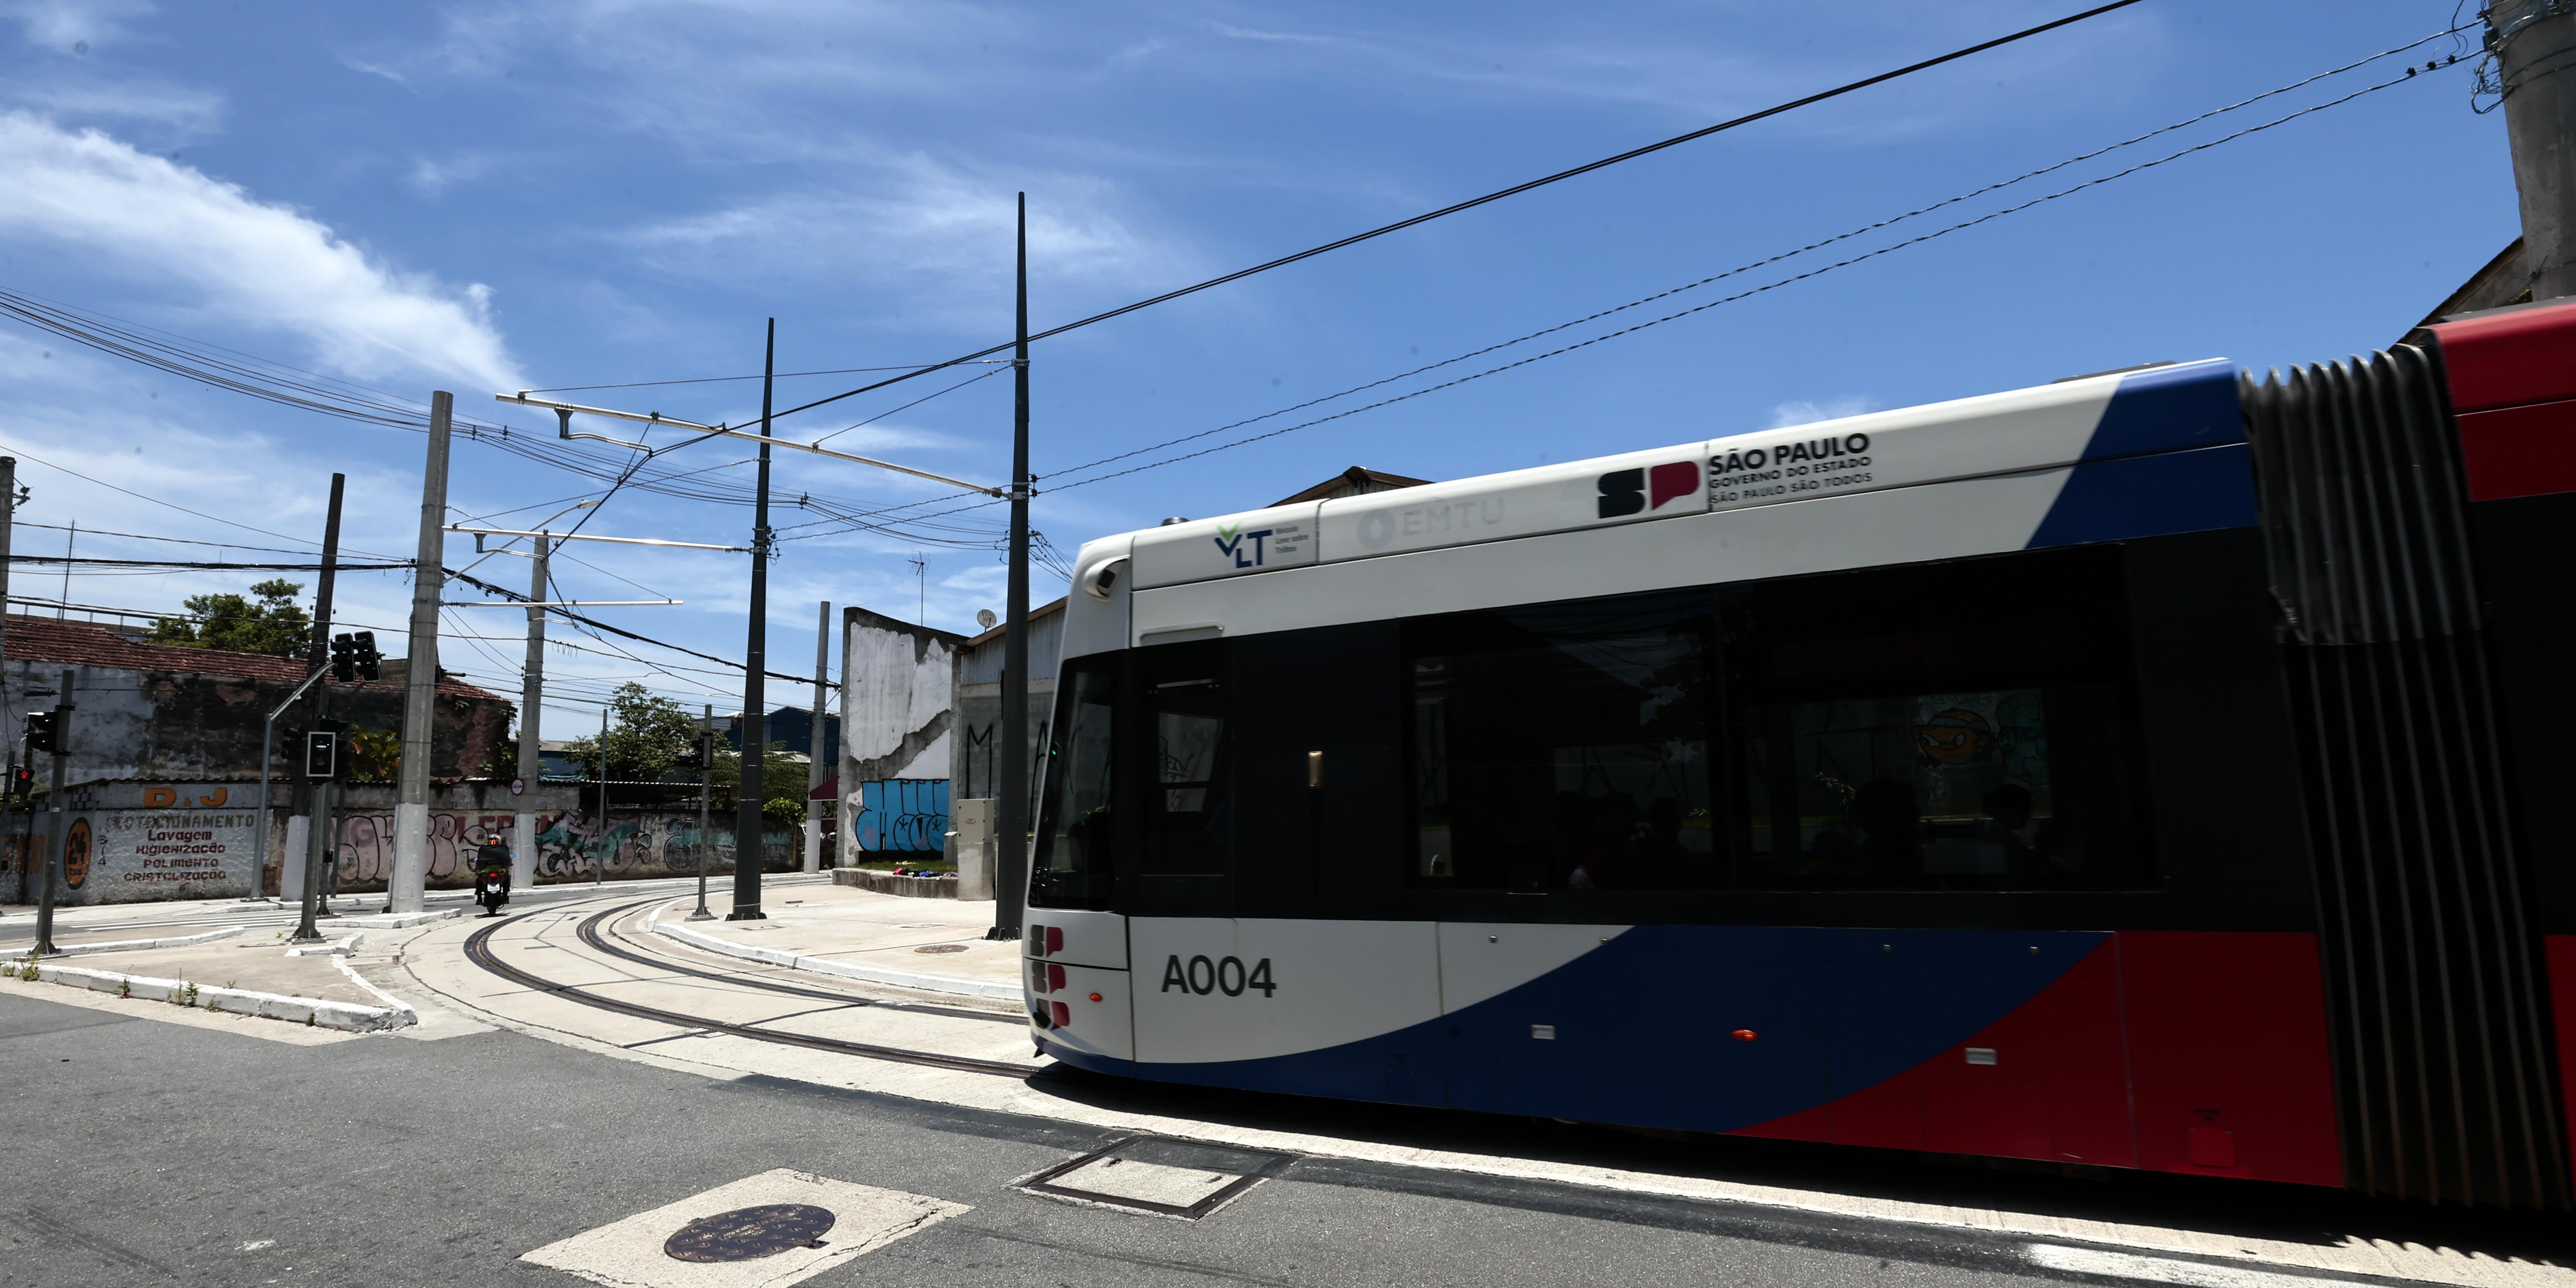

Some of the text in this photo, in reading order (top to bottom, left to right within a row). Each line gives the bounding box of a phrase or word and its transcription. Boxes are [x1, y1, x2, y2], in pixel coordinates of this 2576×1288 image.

[1709, 433, 1869, 475] SÃO PAULO
[1709, 457, 1871, 488] GOVERNO DO ESTADO
[1710, 473, 1873, 504] SÃO PAULO SÃO TODOS
[1403, 497, 1504, 536] EMTU
[1215, 526, 1273, 568] VLT
[144, 787, 177, 807] D
[200, 787, 228, 807] J
[148, 829, 213, 842] Lavagem
[1161, 954, 1277, 998] A004
